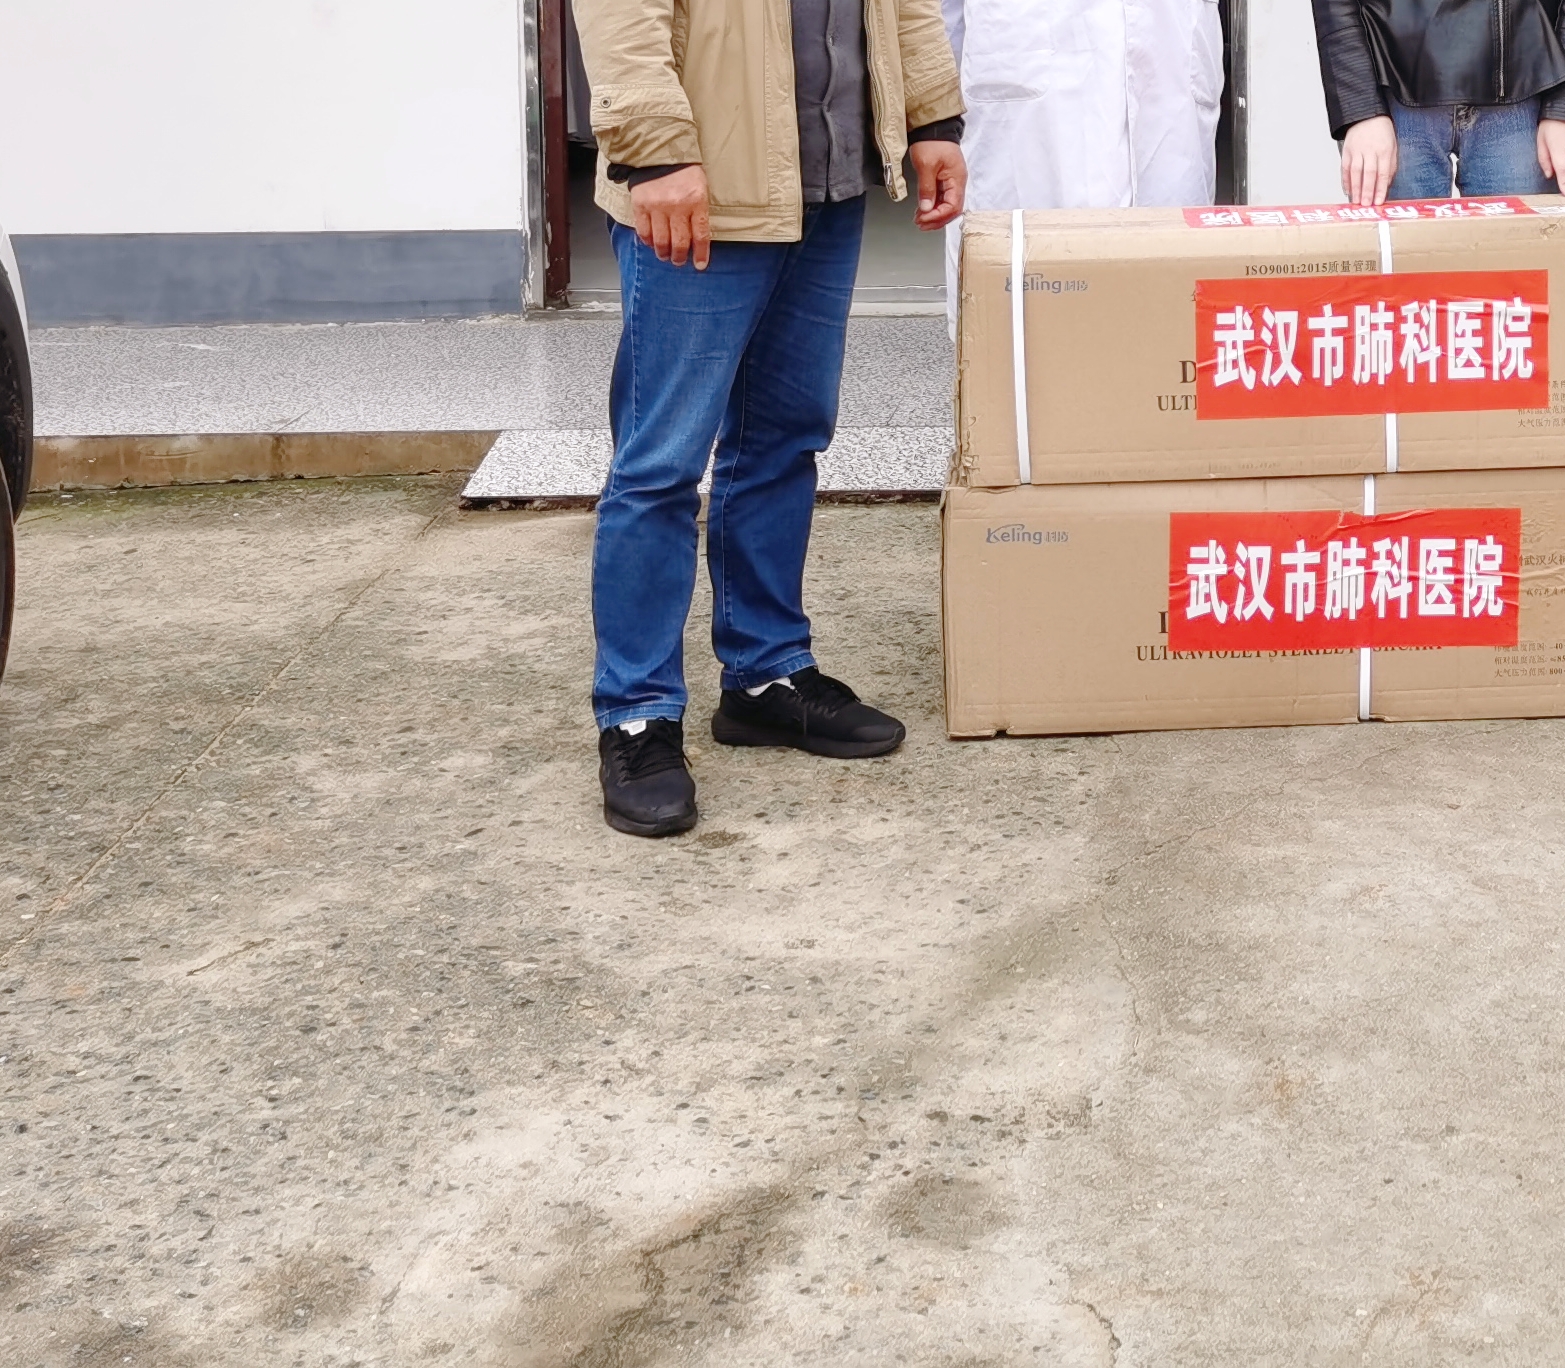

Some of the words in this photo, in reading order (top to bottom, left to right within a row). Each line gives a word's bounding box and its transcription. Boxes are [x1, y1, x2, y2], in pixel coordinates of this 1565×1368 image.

[1200, 201, 1515, 225] 武汉市肺科医院
[1213, 297, 1534, 390] 武汉市肺科医院
[1186, 535, 1505, 624] 武汉市肺科医院
